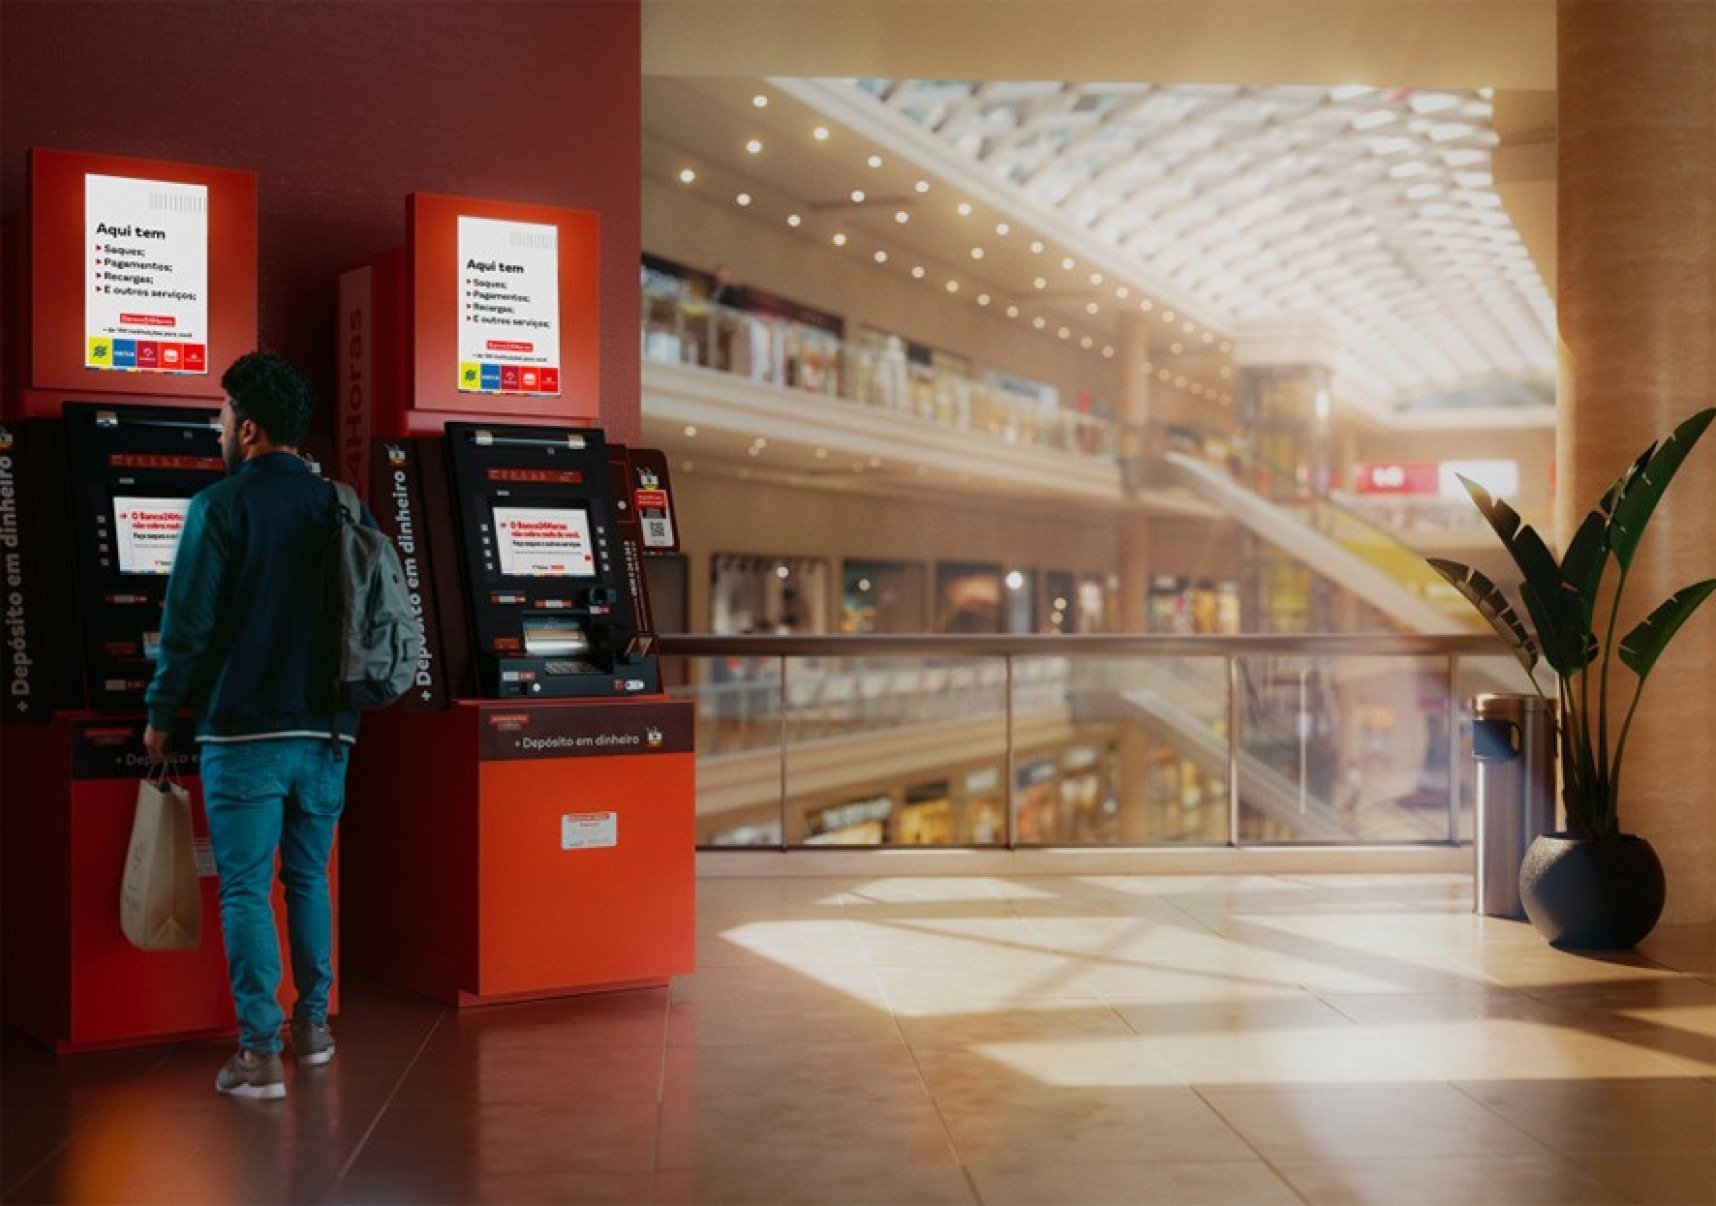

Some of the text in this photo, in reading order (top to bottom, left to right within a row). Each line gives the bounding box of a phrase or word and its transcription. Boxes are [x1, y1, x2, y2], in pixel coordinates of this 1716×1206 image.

[96, 222, 165, 240] Aqui tem
[104, 244, 145, 257] Saques;
[104, 258, 173, 273] Pagamentos;
[467, 258, 524, 273] Aqui tem
[104, 272, 154, 285] Recargas;
[104, 285, 197, 301] E outros serviços;
[481, 316, 511, 326] outros
[0, 455, 19, 547] dinheiro
[393, 470, 415, 553] dinheiro
[6, 553, 22, 586] em
[405, 557, 419, 589] em
[7, 592, 33, 696] Depósito
[522, 736, 574, 750] Depósito
[576, 738, 593, 746] em
[595, 733, 640, 746] dinheiro
